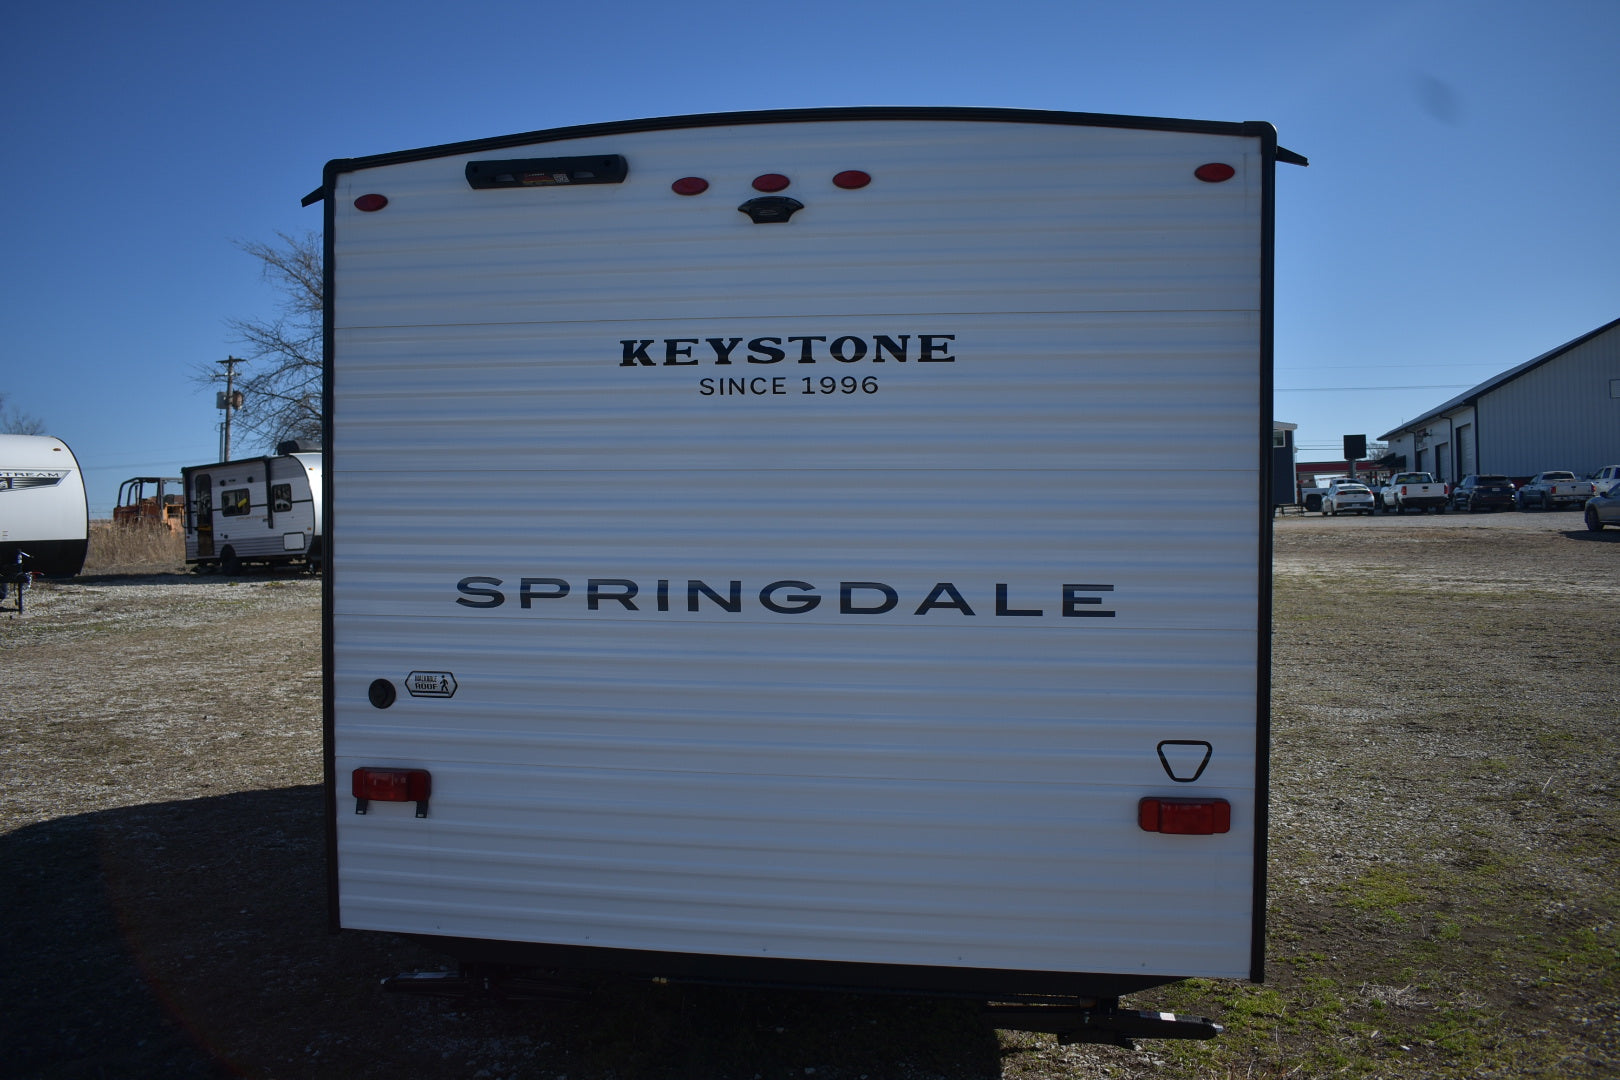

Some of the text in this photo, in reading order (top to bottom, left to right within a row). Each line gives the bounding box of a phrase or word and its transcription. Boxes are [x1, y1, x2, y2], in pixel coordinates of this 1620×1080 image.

[619, 334, 956, 367] KEYSTONE
[699, 375, 879, 396] SINCE 1996
[455, 576, 1116, 618] SPRINGDALE
